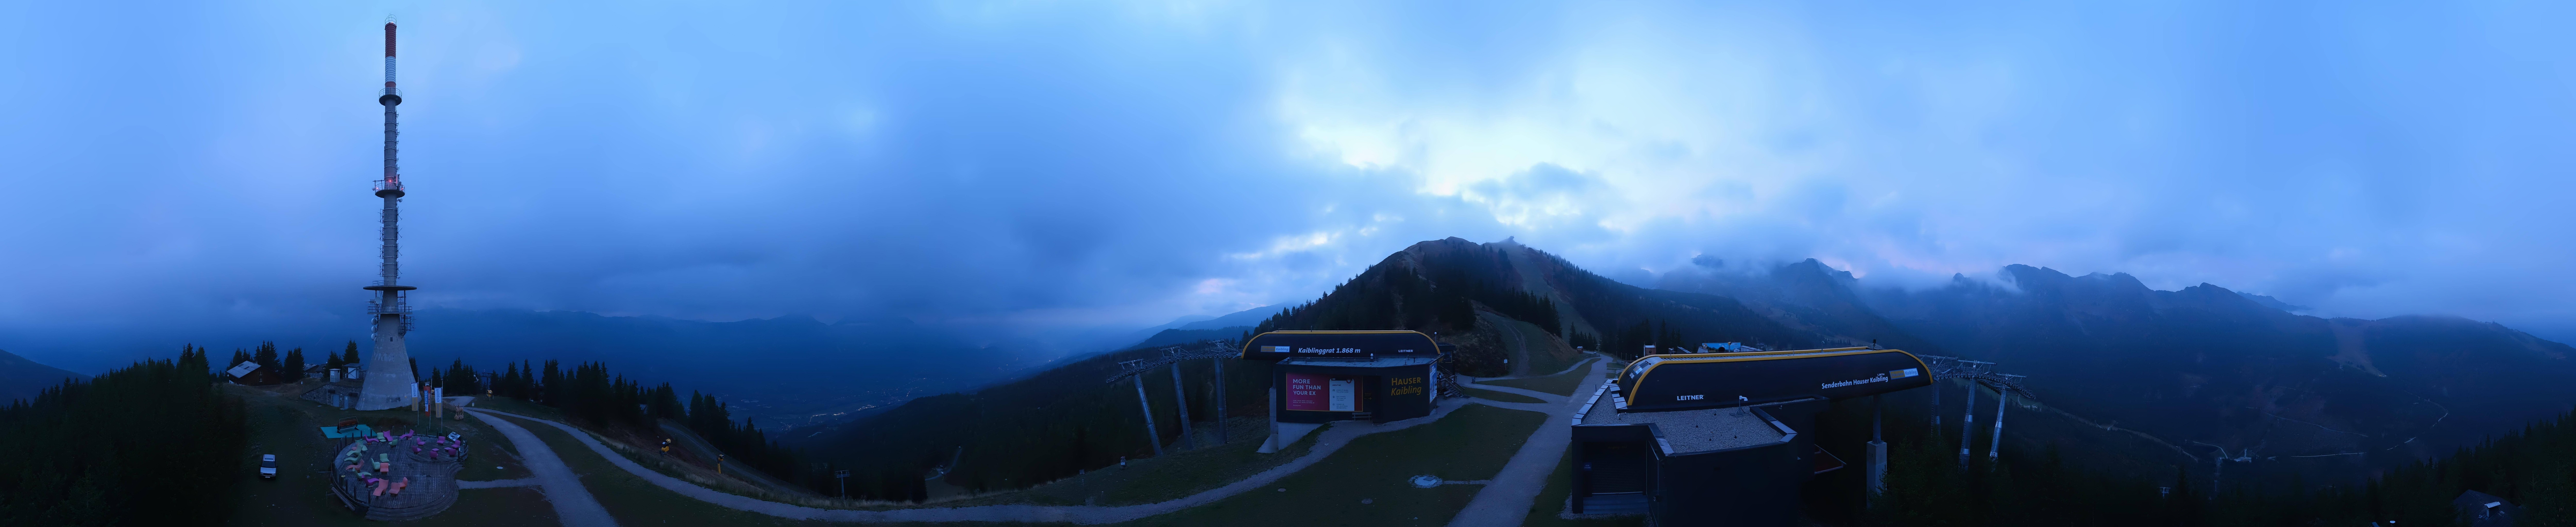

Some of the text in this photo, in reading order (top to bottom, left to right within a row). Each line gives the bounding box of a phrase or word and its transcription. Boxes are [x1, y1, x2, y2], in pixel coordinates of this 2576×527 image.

[1392, 377, 1421, 386] HAUSER
[1822, 380, 1852, 389] Senderbahn
[1391, 386, 1422, 396] Kaibling
